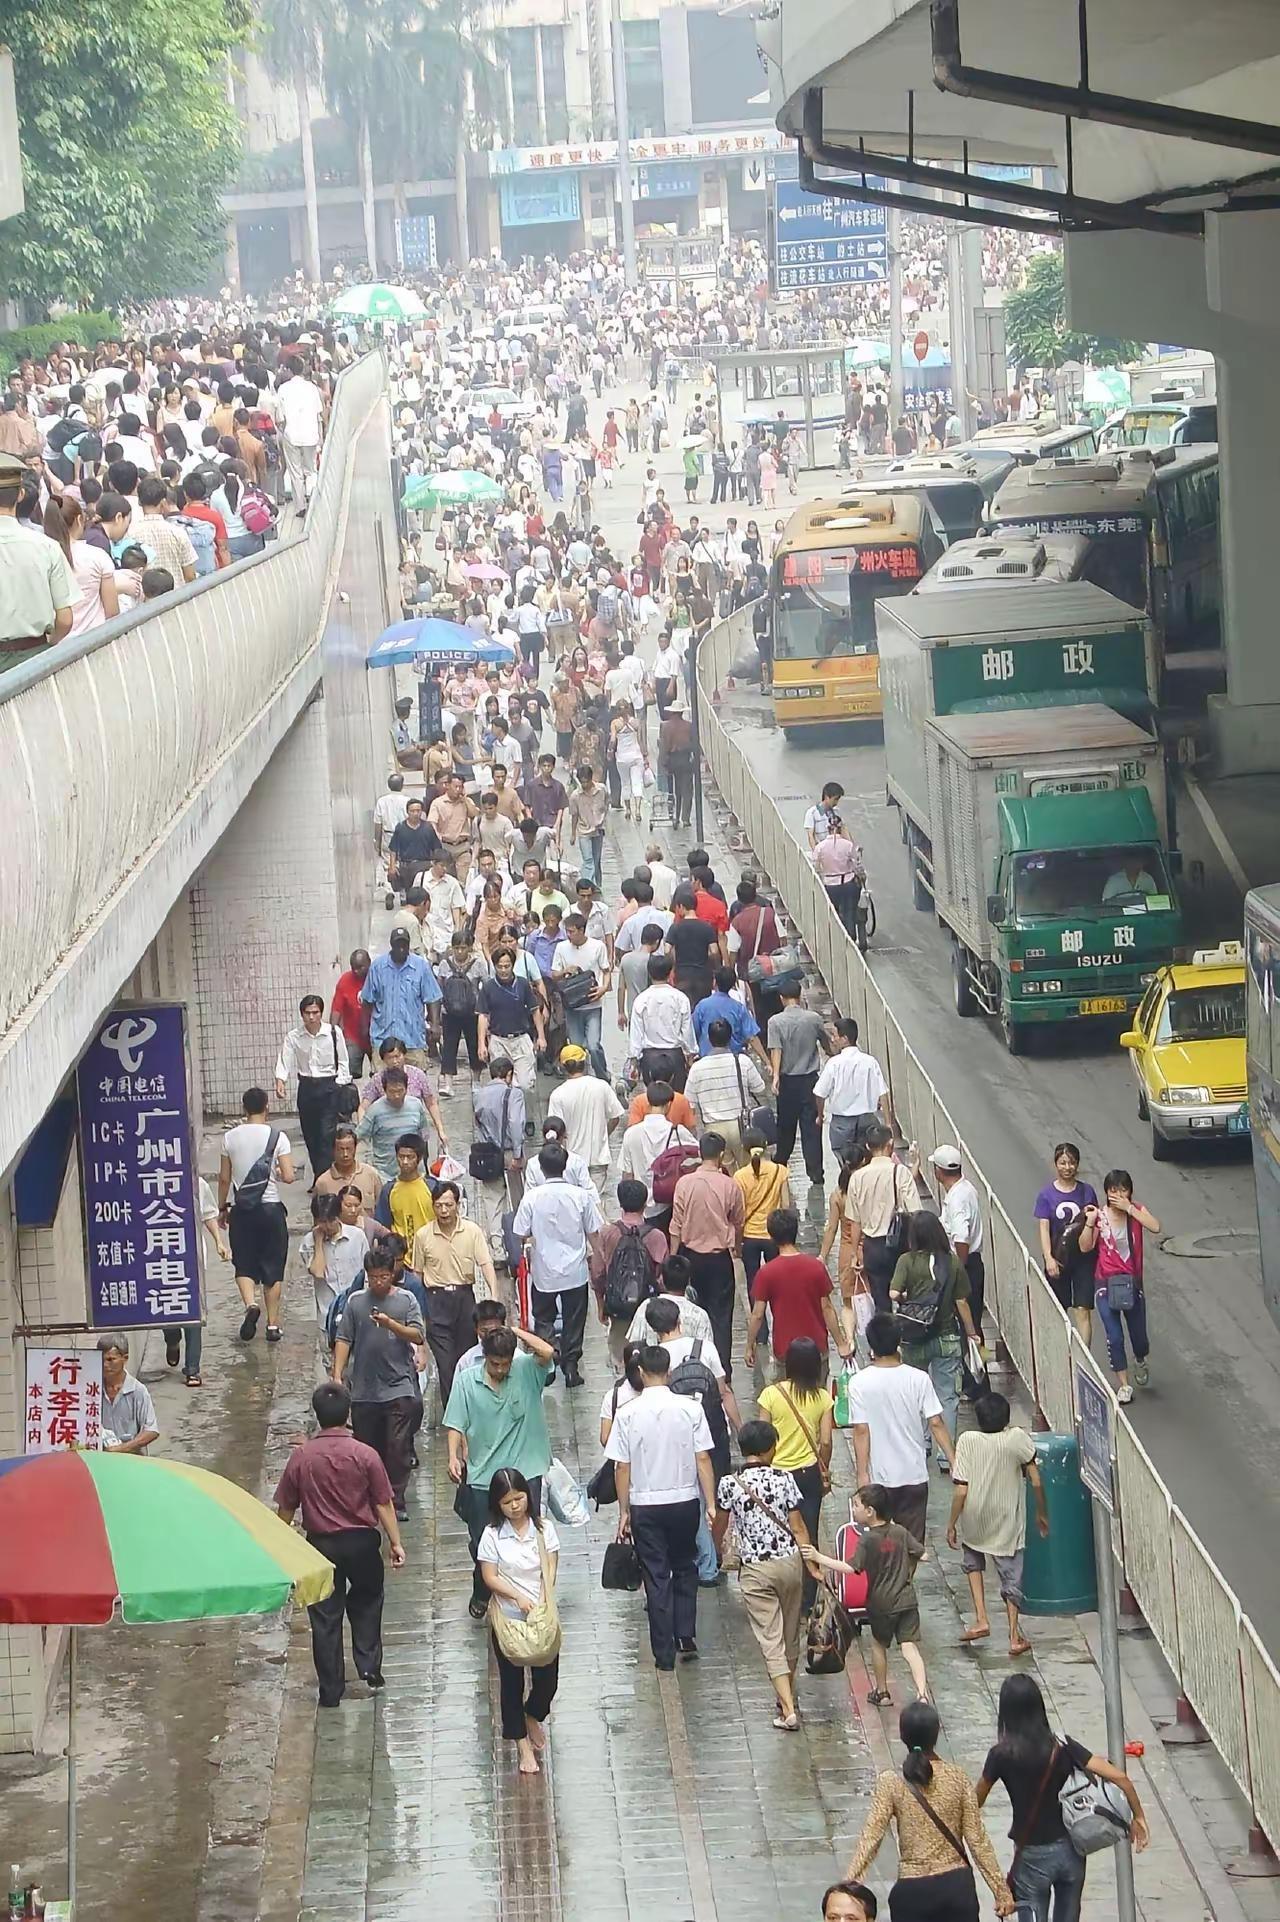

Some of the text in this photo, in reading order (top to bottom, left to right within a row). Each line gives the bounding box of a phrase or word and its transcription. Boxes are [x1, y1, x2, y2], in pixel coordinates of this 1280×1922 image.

[423, 651, 472, 660] POLICE
[1077, 954, 1122, 967] ISUZU
[99, 1074, 165, 1096] 中国电信
[129, 1094, 167, 1102] TELECOM
[95, 1200, 132, 1225] 200卡
[135, 1107, 191, 1315] 广州市公用电话
[97, 1240, 135, 1266] 充值卡
[100, 1280, 138, 1306] 全国通用
